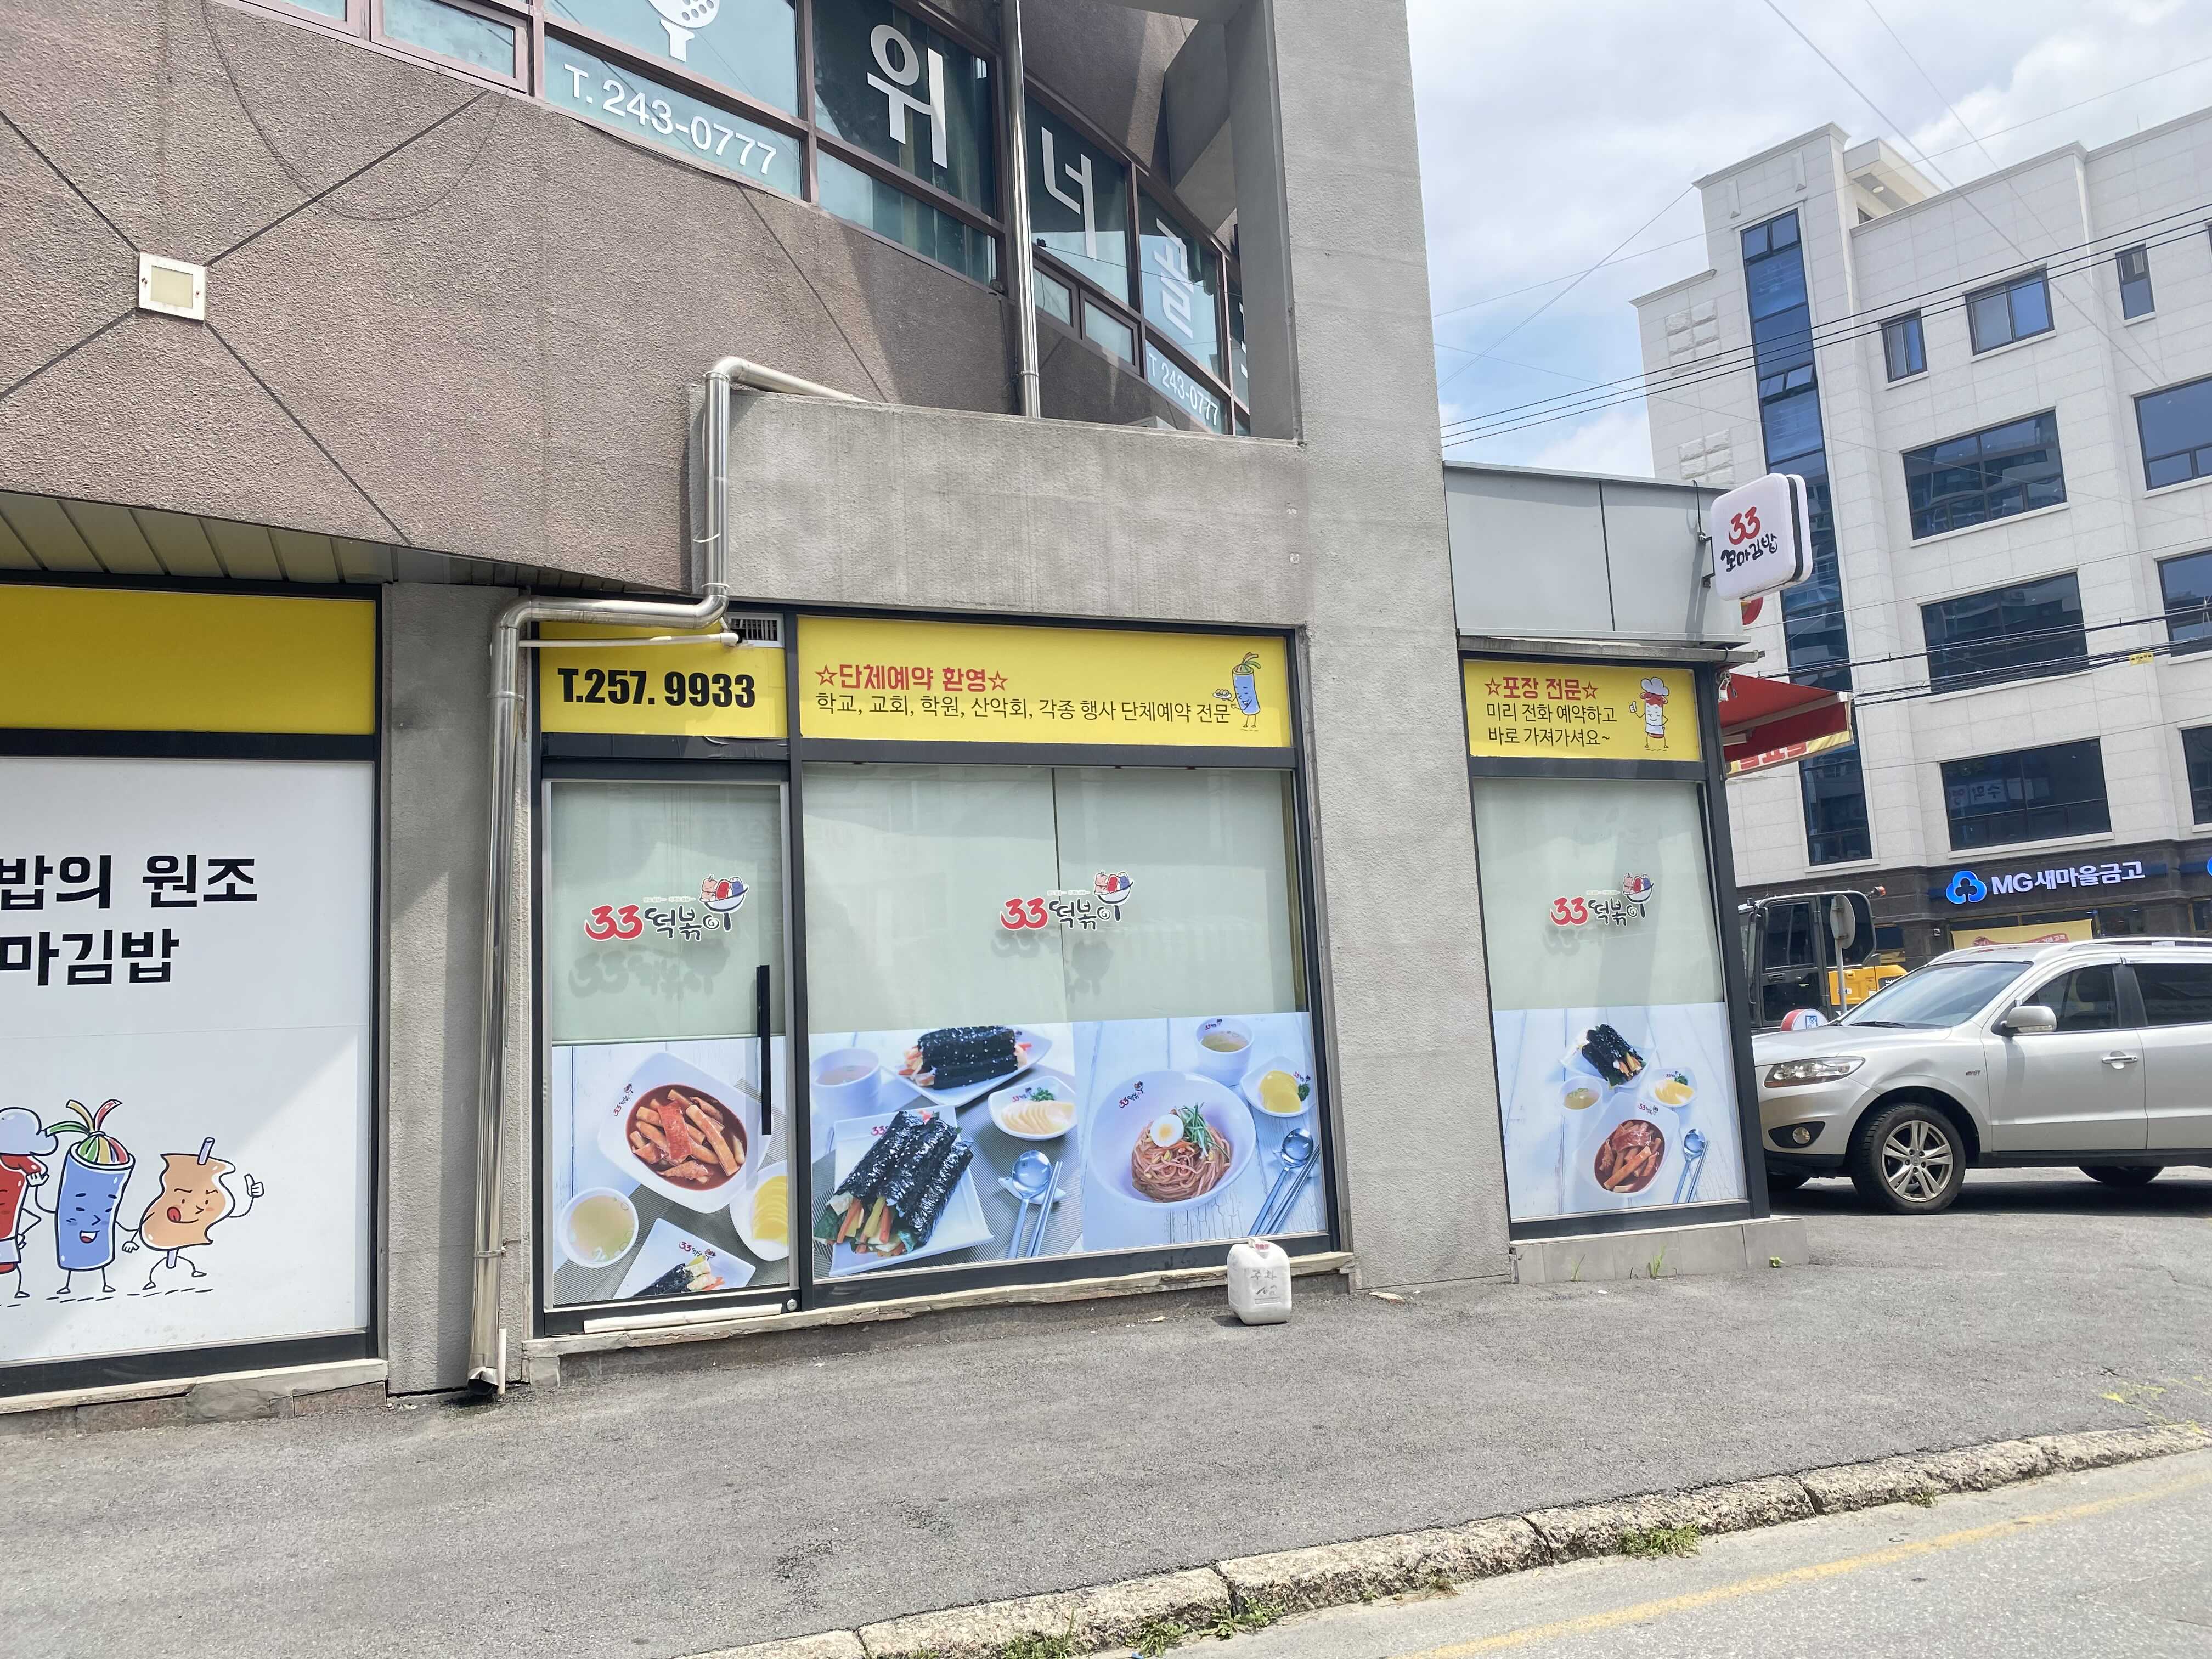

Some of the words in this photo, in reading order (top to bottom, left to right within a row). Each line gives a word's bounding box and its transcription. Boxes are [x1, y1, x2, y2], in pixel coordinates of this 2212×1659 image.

[602, 79, 777, 176] 243-0777
[1161, 362, 1218, 426] 243-0777
[1728, 506, 1760, 545] 33
[1720, 533, 1778, 572] 꼬마김밥
[664, 672, 755, 708] 9933
[839, 664, 934, 691] 단체예약
[942, 667, 986, 692] 환영
[1502, 676, 1538, 699] 포장
[1545, 678, 1582, 701] 전문
[816, 692, 862, 715] 학교,
[868, 695, 914, 716] 교회,
[920, 696, 964, 718] 학원,
[970, 697, 1032, 719] 산악회,
[1039, 699, 1076, 720] 각종
[1080, 700, 1116, 721] 행사
[1121, 701, 1192, 723] 단체예약
[1196, 703, 1231, 724] 전문
[1487, 702, 1517, 721] 미리
[1521, 703, 1553, 723] 전화
[1556, 704, 1617, 725] 예약하고
[1488, 726, 1520, 746] 바로
[1523, 727, 1610, 748] 가져가셔요~
[0, 854, 112, 911] 밥의
[143, 854, 258, 909] 원조
[1991, 861, 2146, 895] MG새마을금고
[0, 928, 179, 986] 마김밥
